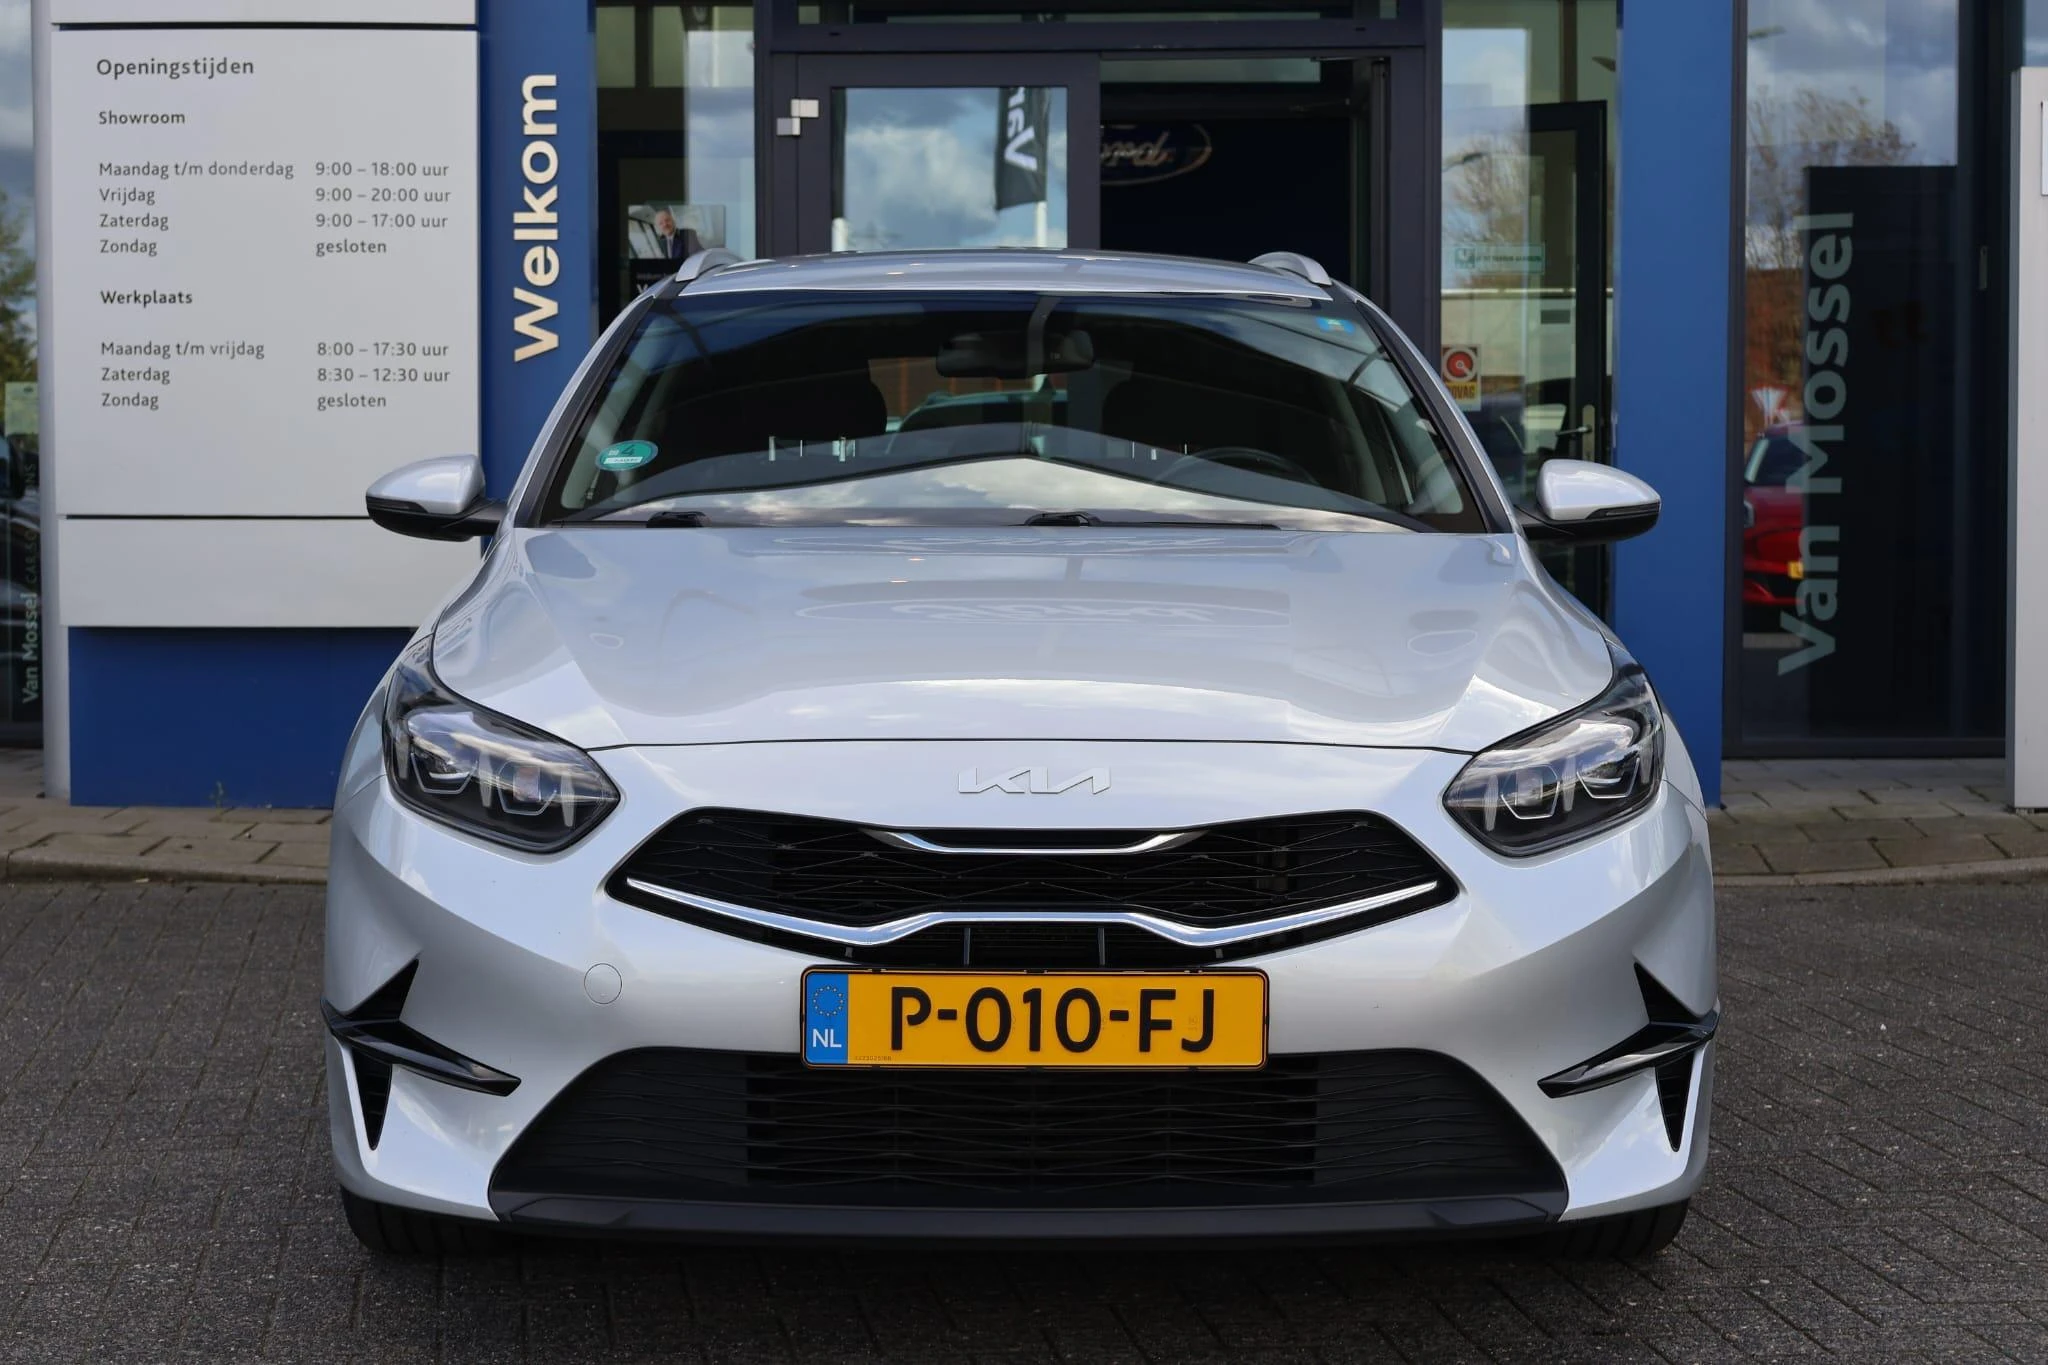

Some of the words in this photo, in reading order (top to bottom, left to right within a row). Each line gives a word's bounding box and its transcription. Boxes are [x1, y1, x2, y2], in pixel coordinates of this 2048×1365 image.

[97, 57, 254, 80] Openingstijden
[99, 110, 185, 124] Showroom
[99, 161, 169, 180] Maandag
[174, 161, 203, 176] t/m
[208, 161, 294, 180] donderdag
[316, 162, 352, 176] 9:00
[372, 162, 416, 176] 18:00
[423, 166, 449, 176] uur
[99, 187, 155, 206] Vrijdag
[316, 188, 352, 201] 9:00
[371, 188, 418, 202] 20:00
[424, 192, 451, 202] uur
[100, 213, 169, 231] Zaterdag
[316, 213, 352, 227] 9:00
[372, 214, 415, 227] 17:00
[421, 218, 448, 228] uur
[514, 73, 559, 362] Welkom
[100, 238, 157, 257] Zondag
[316, 239, 386, 257] gesloten
[100, 289, 192, 308] Werkplaats
[101, 340, 171, 359] Maandag
[176, 341, 204, 356] t/m
[210, 341, 264, 360] vrijdag
[317, 342, 354, 356] 8:00
[373, 342, 416, 356] 17:30
[422, 346, 448, 356] uur
[1785, 212, 1854, 494] Mossel
[102, 367, 170, 385] Zaterdag
[318, 368, 354, 381] 8:30
[373, 368, 418, 382] 12:30
[424, 372, 450, 382] uur
[1449, 384, 1476, 399] OVAG
[102, 392, 159, 411] Zondag
[317, 393, 386, 411] gesloten
[1778, 526, 1840, 676] Van
[21, 592, 38, 661] Mossel
[22, 667, 39, 703] Van
[890, 986, 1215, 1053] P-010-FJ
[812, 1028, 842, 1048] NL
